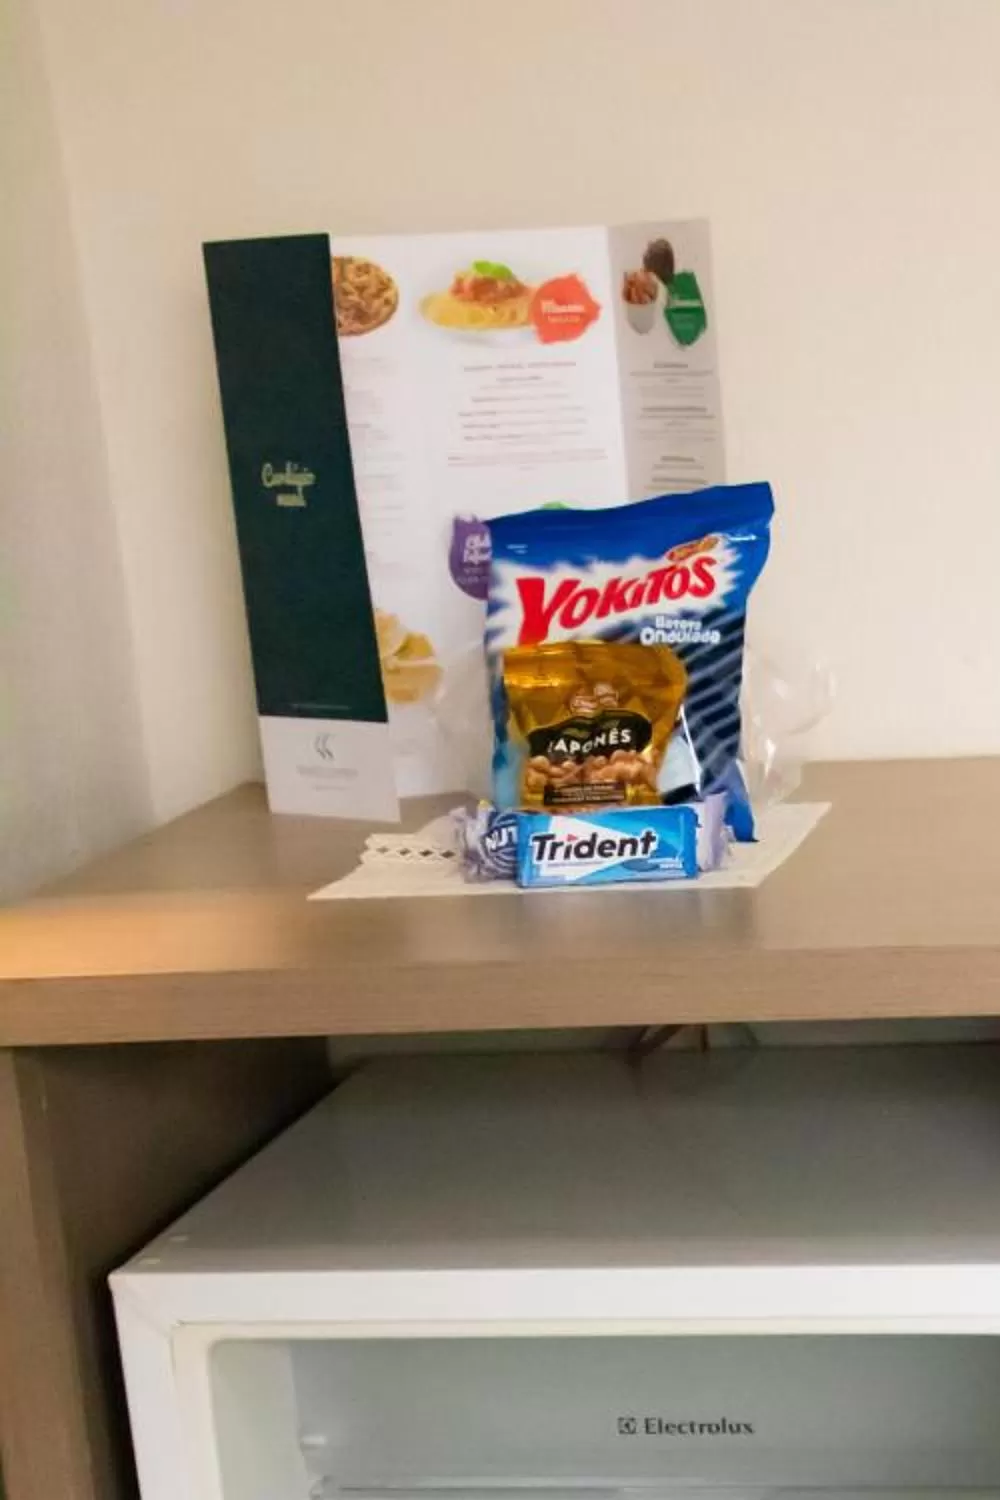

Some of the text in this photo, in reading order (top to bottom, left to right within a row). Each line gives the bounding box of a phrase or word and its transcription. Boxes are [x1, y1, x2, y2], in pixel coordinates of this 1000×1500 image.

[547, 727, 632, 754] JAPONÊS
[531, 831, 656, 861] Trident
[644, 1416, 755, 1435] Electrolux
